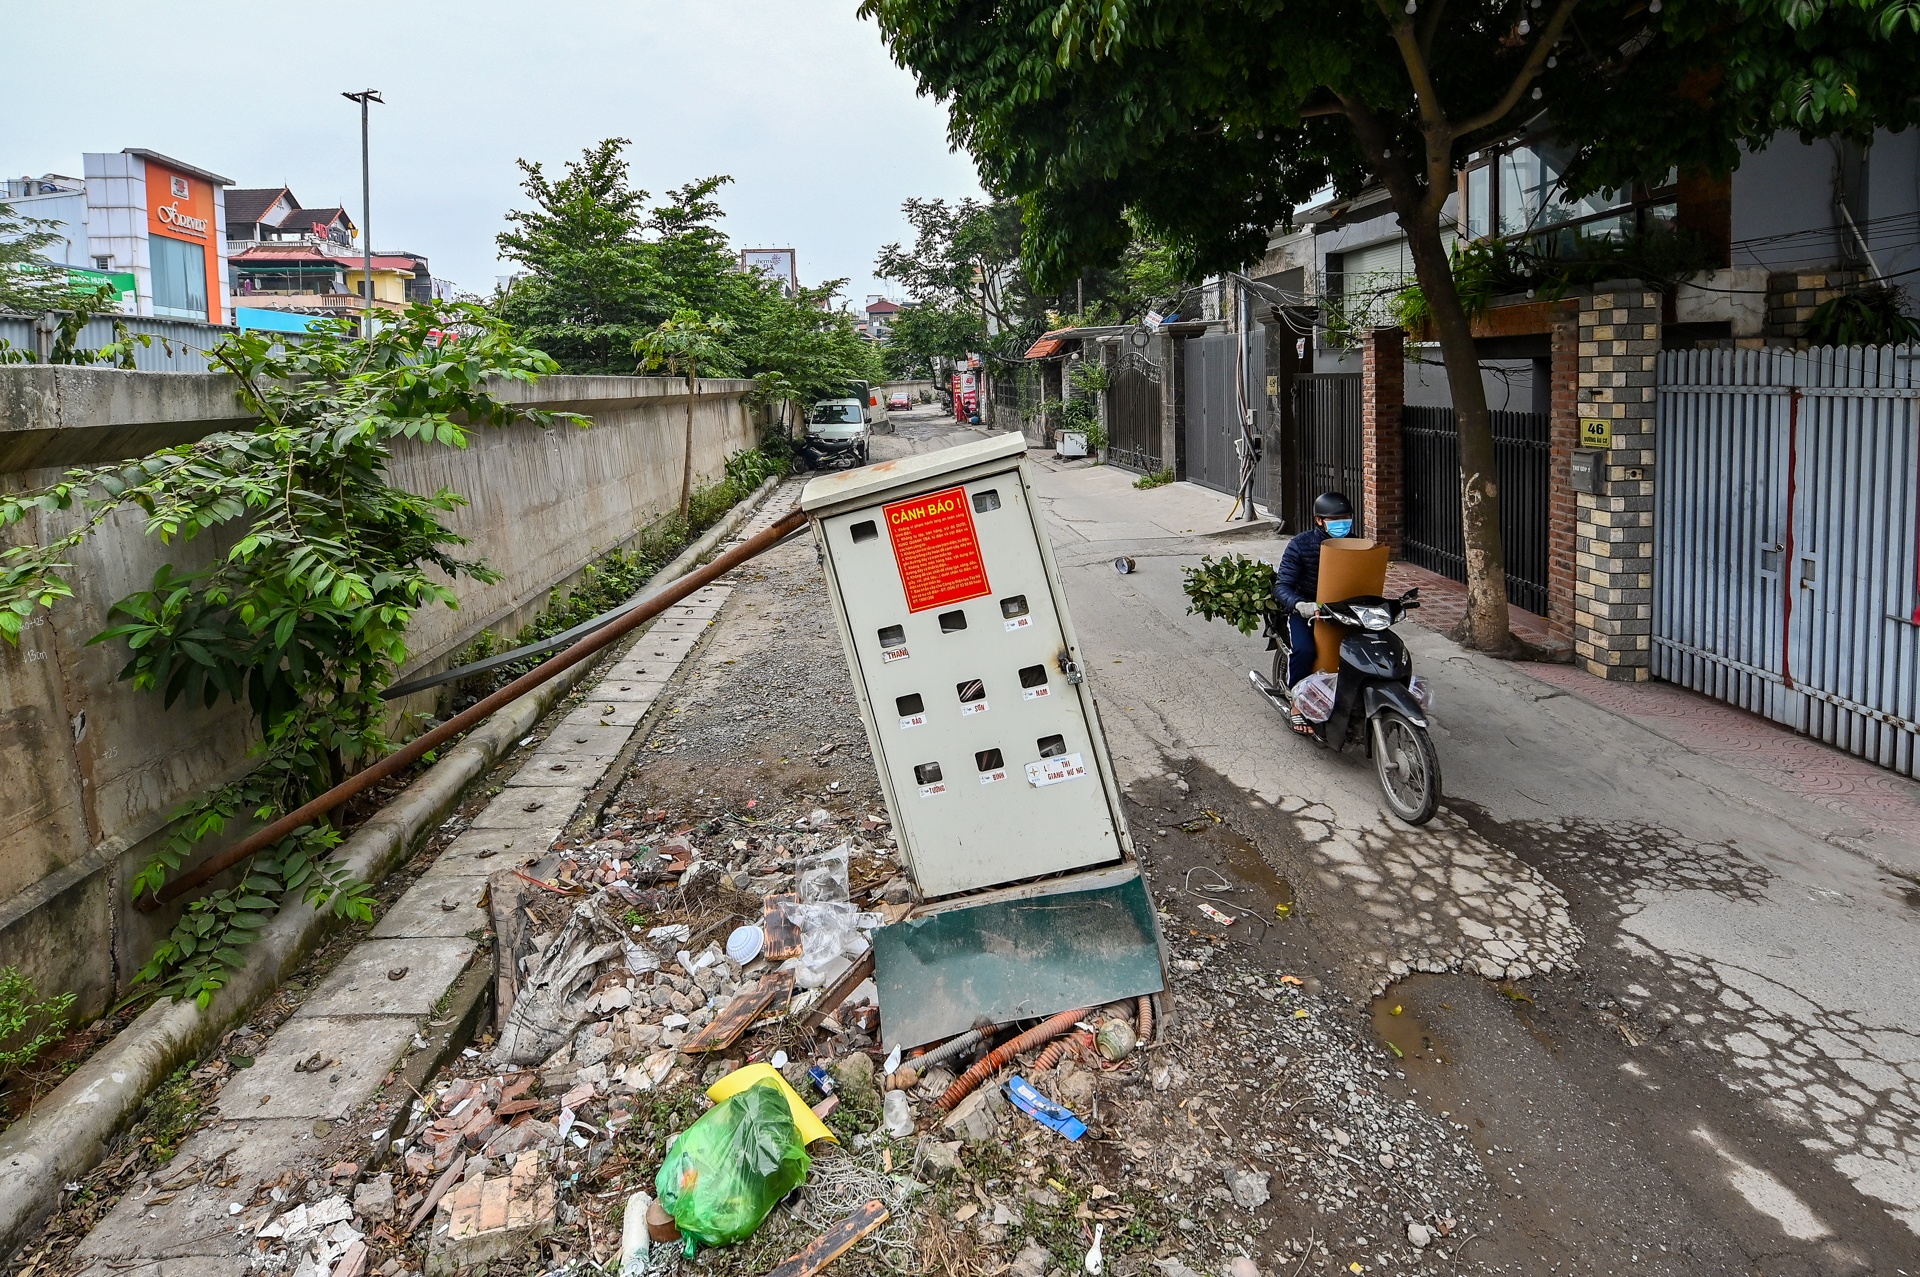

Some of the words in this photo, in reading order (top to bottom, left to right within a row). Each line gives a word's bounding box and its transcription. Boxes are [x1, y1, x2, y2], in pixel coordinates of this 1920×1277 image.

[1588, 423, 1604, 435] 46
[892, 507, 925, 524] CẢNH
[928, 500, 954, 515] BÁO
